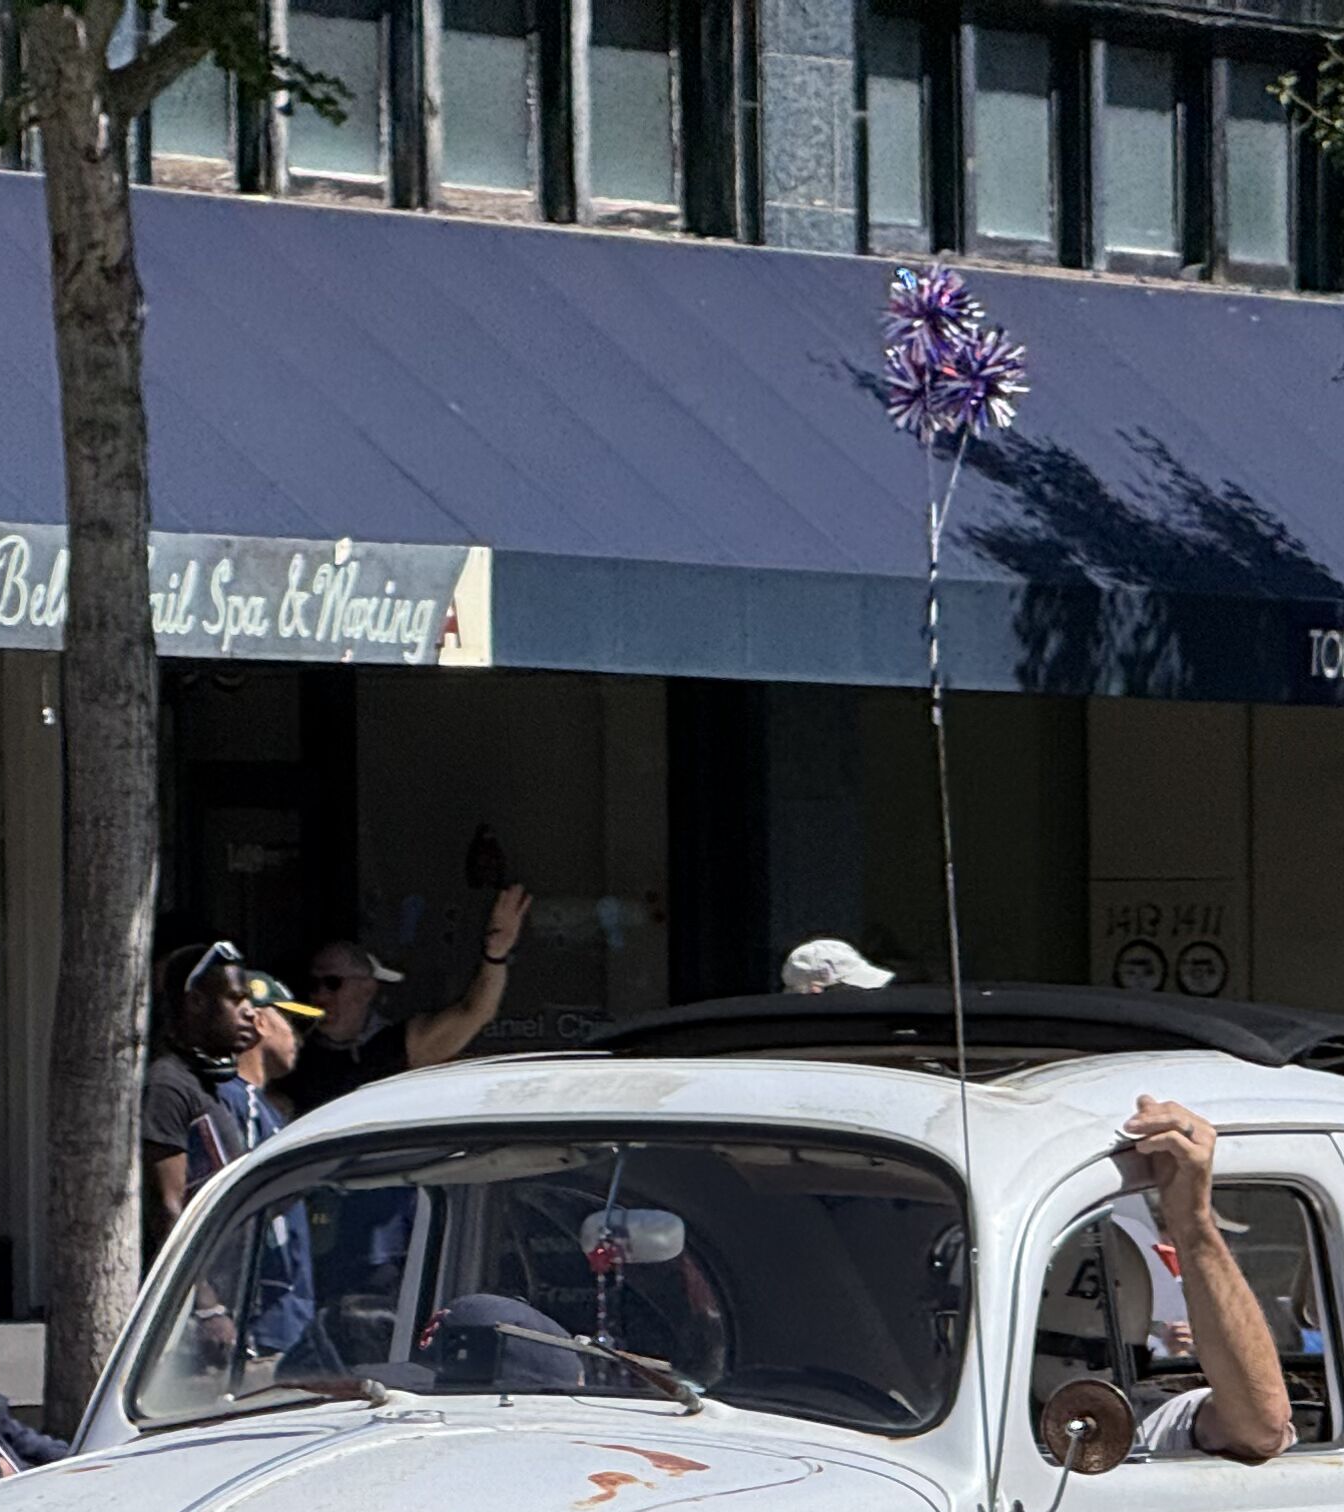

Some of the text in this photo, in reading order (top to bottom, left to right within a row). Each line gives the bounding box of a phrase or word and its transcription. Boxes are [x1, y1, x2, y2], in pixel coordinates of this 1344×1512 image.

[202, 556, 269, 652] Spa
[278, 552, 311, 638] &
[312, 557, 438, 662] Waxing
[483, 1014, 544, 1038] aniel
